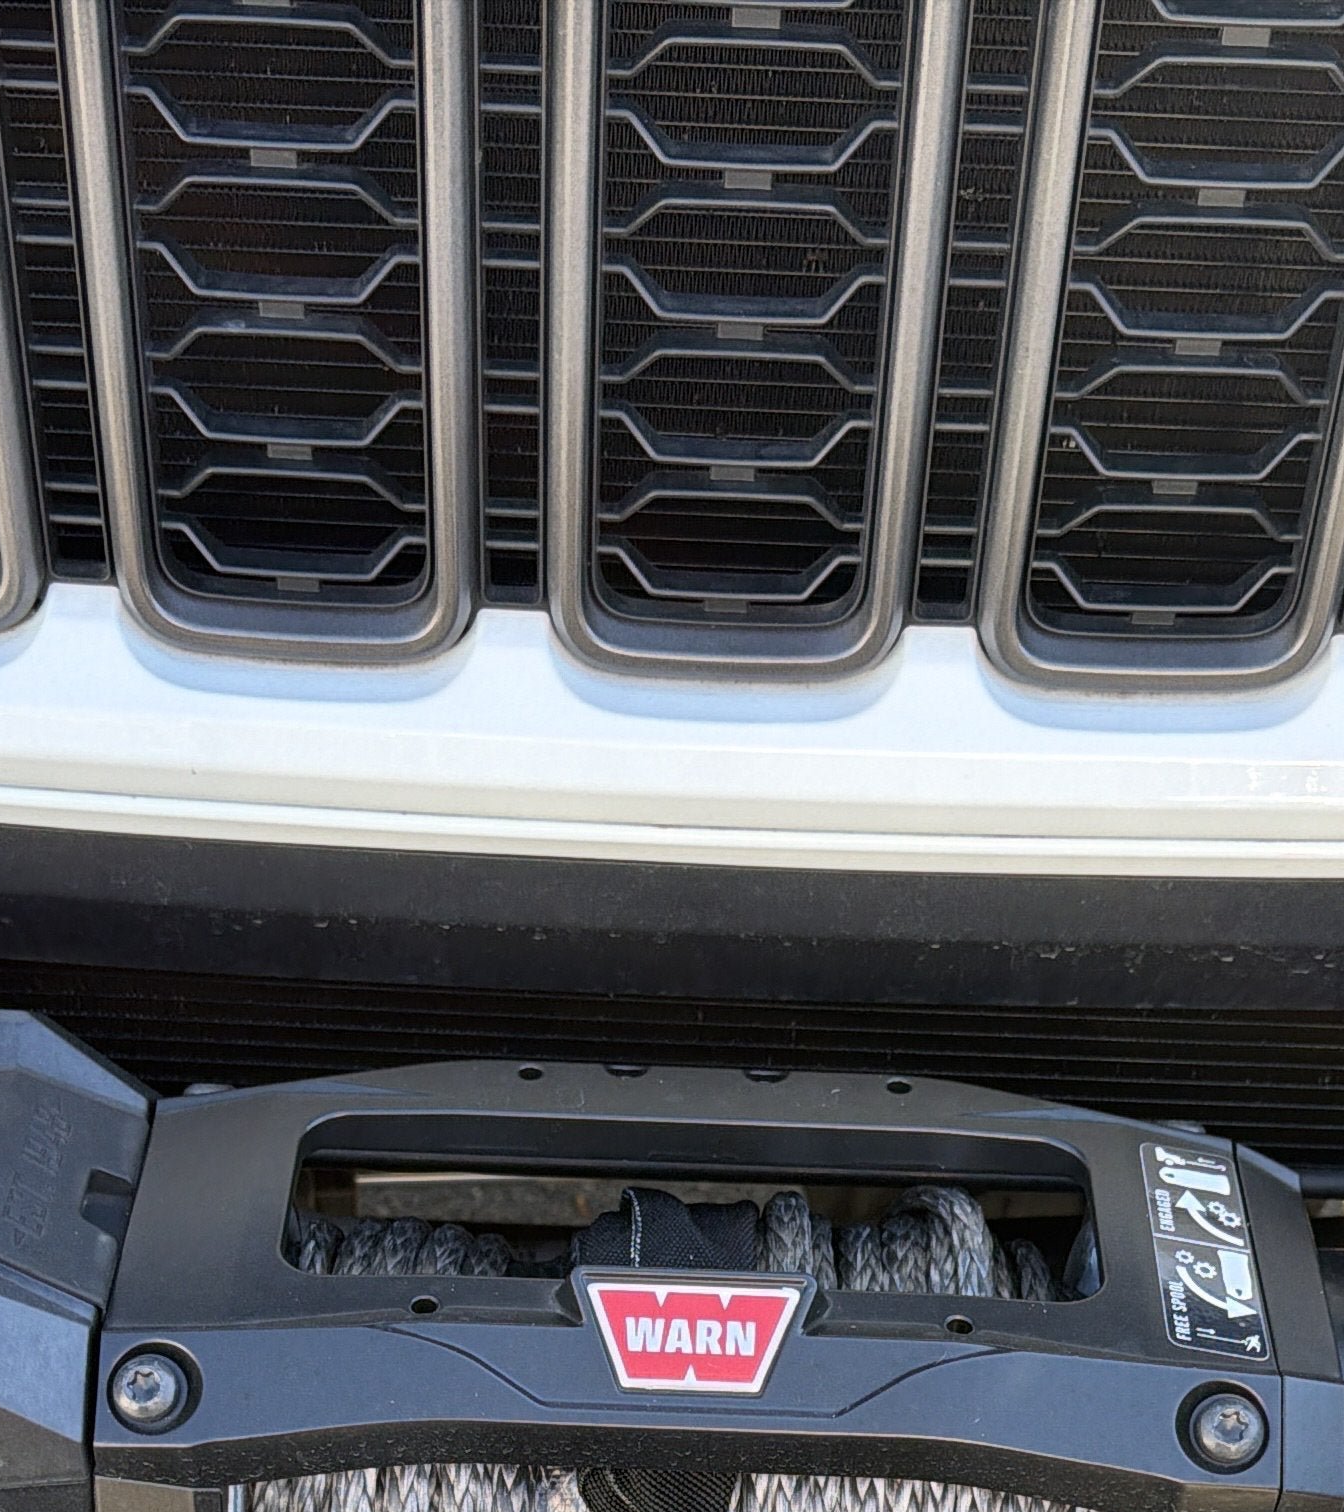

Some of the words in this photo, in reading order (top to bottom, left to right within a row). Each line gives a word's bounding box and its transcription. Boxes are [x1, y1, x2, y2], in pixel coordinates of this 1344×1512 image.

[1155, 1188, 1176, 1233] ENGAGED
[1169, 1280, 1187, 1313] SPOOL
[624, 1316, 756, 1357] WARN
[1173, 1313, 1192, 1342] FREE
